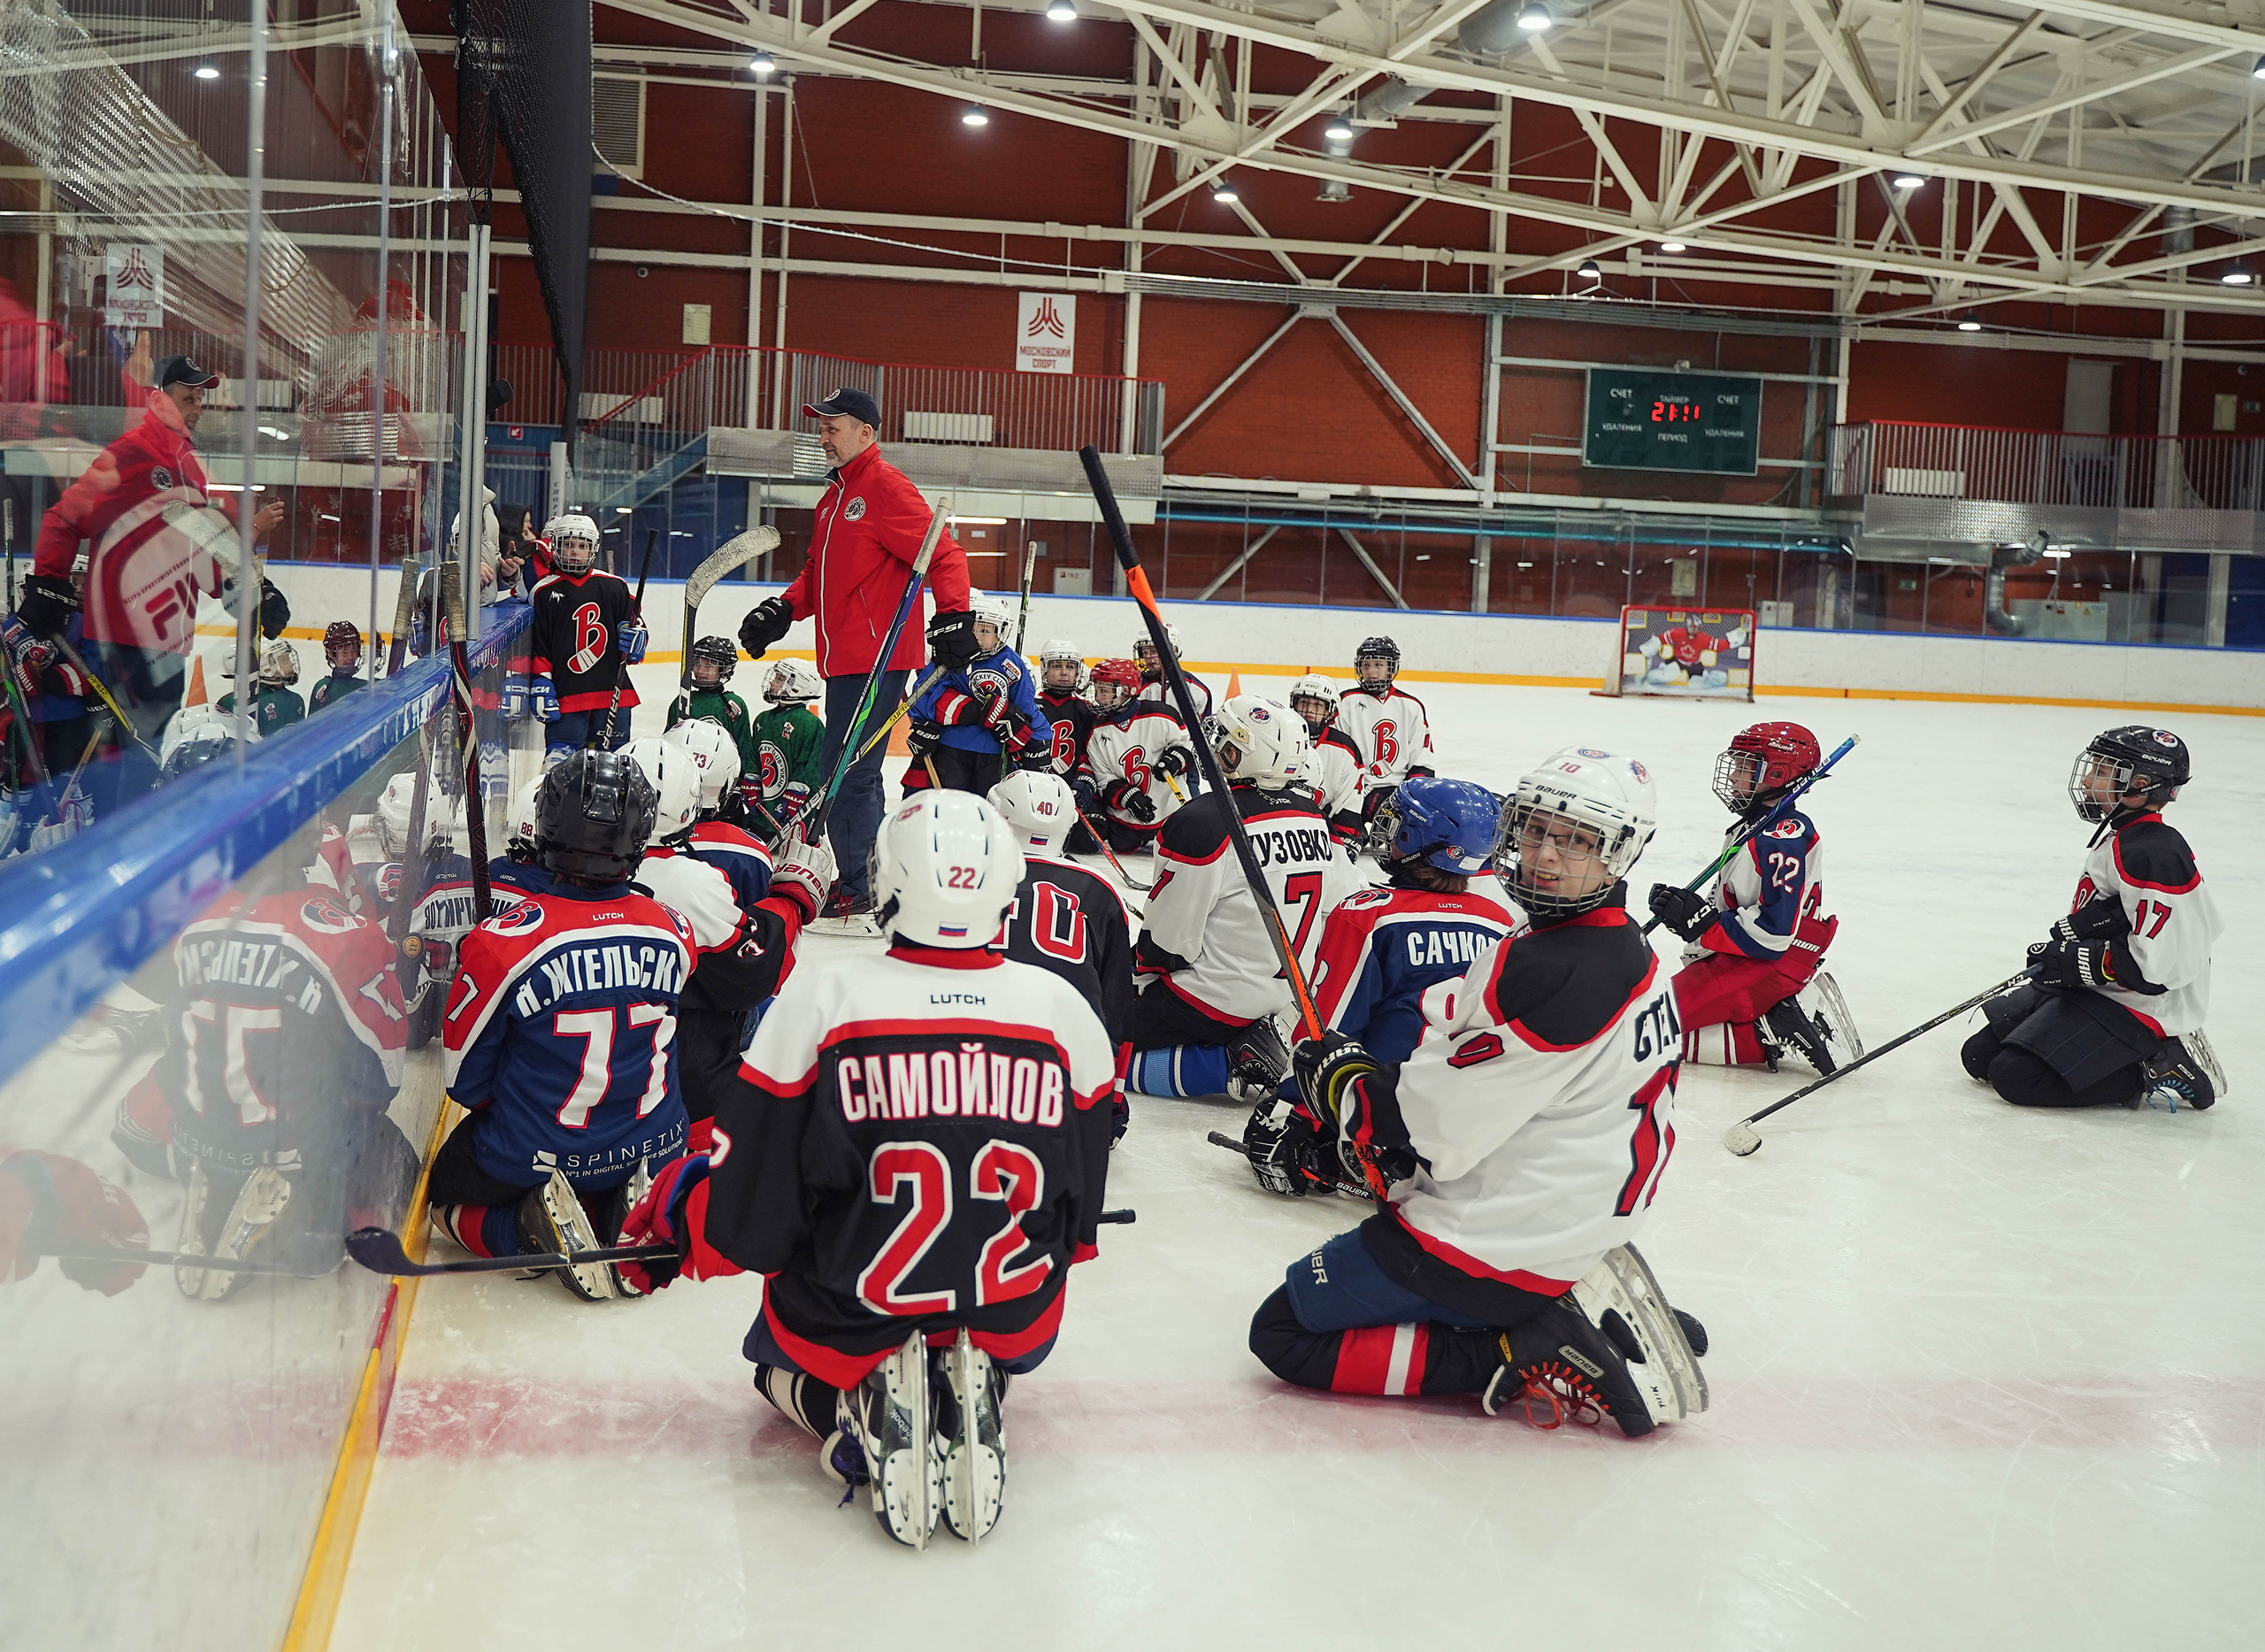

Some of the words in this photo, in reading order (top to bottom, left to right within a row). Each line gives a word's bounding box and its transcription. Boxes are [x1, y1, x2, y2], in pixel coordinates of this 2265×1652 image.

[1032, 358, 1056, 368] СПОРТ
[926, 622, 963, 638] EFSI
[1557, 762, 1581, 773] 10
[2141, 754, 2172, 765] BAUER
[1535, 784, 1578, 800] BAUER
[1037, 801, 1053, 816] 40
[1409, 809, 1428, 823] BAUER
[520, 822, 534, 836] 88
[949, 866, 976, 889] 22
[1769, 851, 1800, 894] 22
[592, 912, 625, 921] LUTCH
[2133, 899, 2173, 940] 17
[930, 995, 987, 1006] LUTCH
[553, 1002, 679, 1130] 77
[837, 1042, 1065, 1128] САМОЙЛОВ
[567, 1118, 684, 1168] SPINETIX
[594, 1164, 626, 1176] DIGITAL
[657, 1136, 684, 1158] SOLUTIONS
[1336, 1181, 1370, 1199] BAUER
[856, 1139, 1054, 1317] 22
[1564, 1348, 1599, 1375] BAUER
